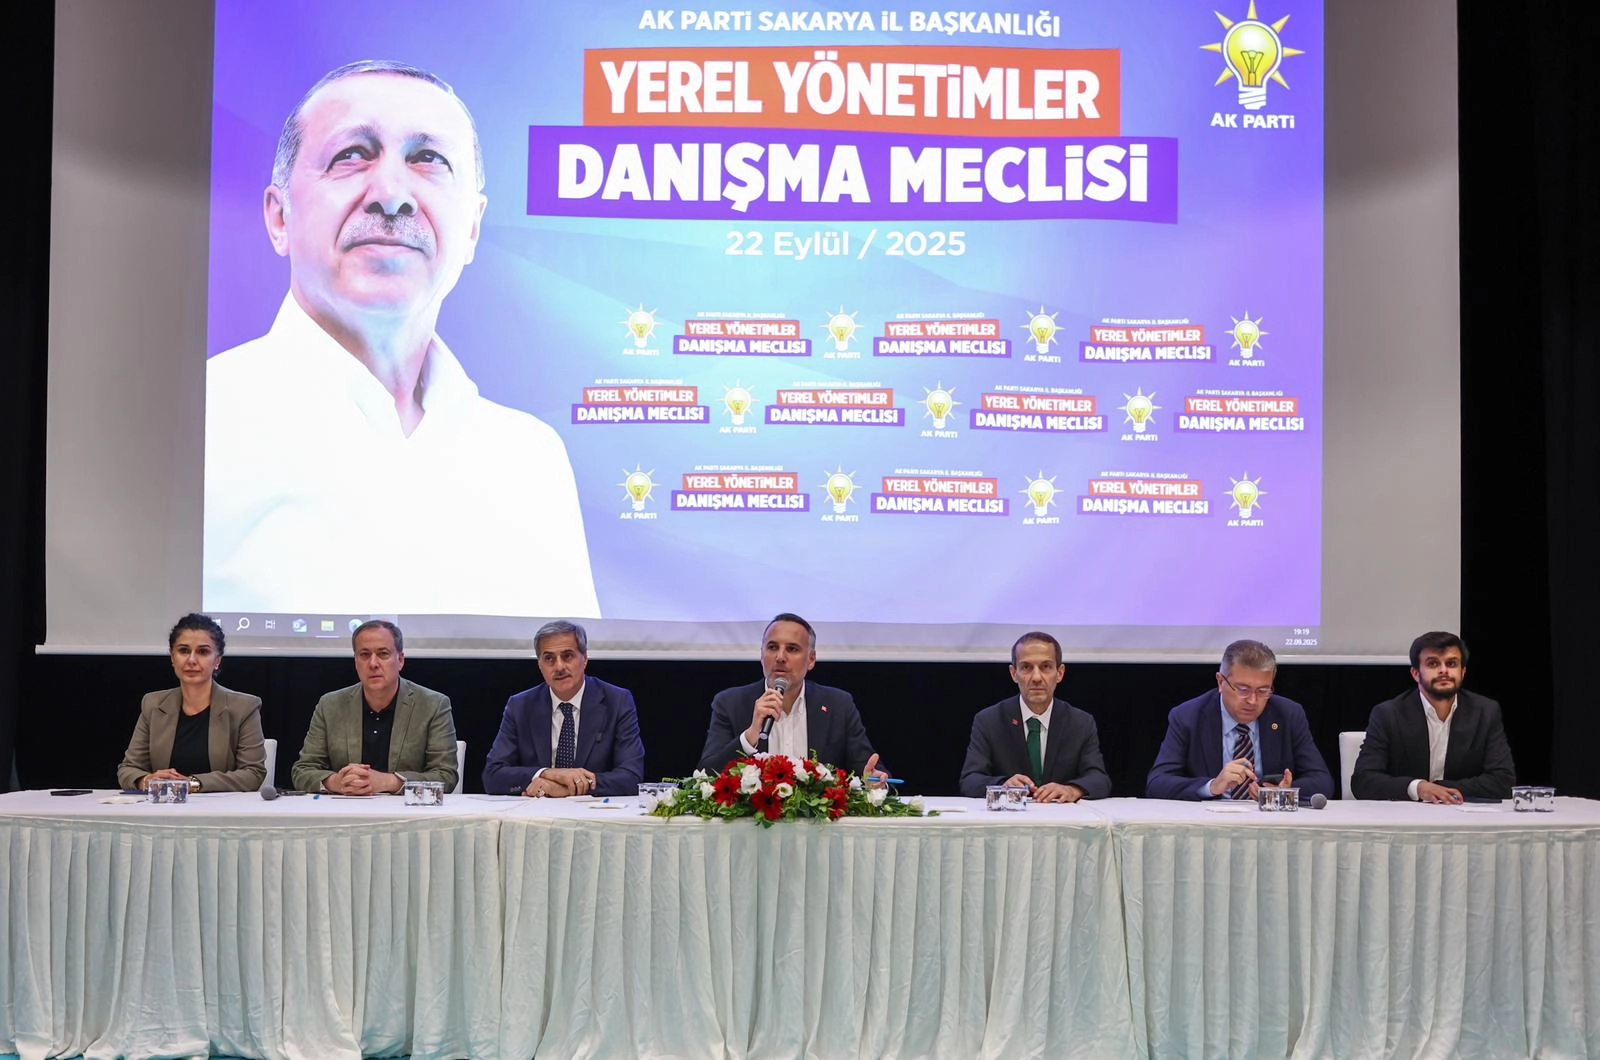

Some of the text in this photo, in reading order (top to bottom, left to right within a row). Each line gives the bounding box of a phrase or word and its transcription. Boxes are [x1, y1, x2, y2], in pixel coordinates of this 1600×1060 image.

[638, 9, 675, 30] AK
[758, 12, 876, 32] SAKARYA
[881, 11, 904, 32] İL
[909, 10, 1060, 38] BAŞKANLIĞI
[600, 50, 1101, 120] YEREL YÖNETİMLER
[1211, 114, 1238, 128] AK
[557, 142, 1148, 213] DANIŞMA MECLİSİ
[724, 228, 966, 261] 22 Eylül / 2025
[688, 323, 723, 335] YEREL
[888, 324, 923, 336] YEREL
[1094, 329, 1129, 342] YEREL
[679, 339, 746, 354] DANIŞMA
[879, 340, 946, 355] DANIŞMA
[1085, 346, 1152, 362] DANIŞMA
[587, 390, 621, 402] YEREL
[780, 391, 815, 404] YEREL
[985, 396, 1020, 409] YEREL
[1188, 399, 1223, 412] YEREL
[577, 407, 645, 422] DANIŞMA
[770, 408, 839, 424] DANIŞMA
[975, 412, 1043, 430] DANIŞMA
[1179, 415, 1247, 432] DANIŞMA
[686, 476, 721, 489] YEREL
[887, 480, 921, 492] YEREL
[1092, 481, 1127, 494] YEREL
[676, 494, 745, 510] DANIŞMA
[876, 497, 945, 513] DANIŞMA
[1082, 498, 1151, 514] DANIŞMA
[1285, 638, 1318, 646] 22.09.2025
